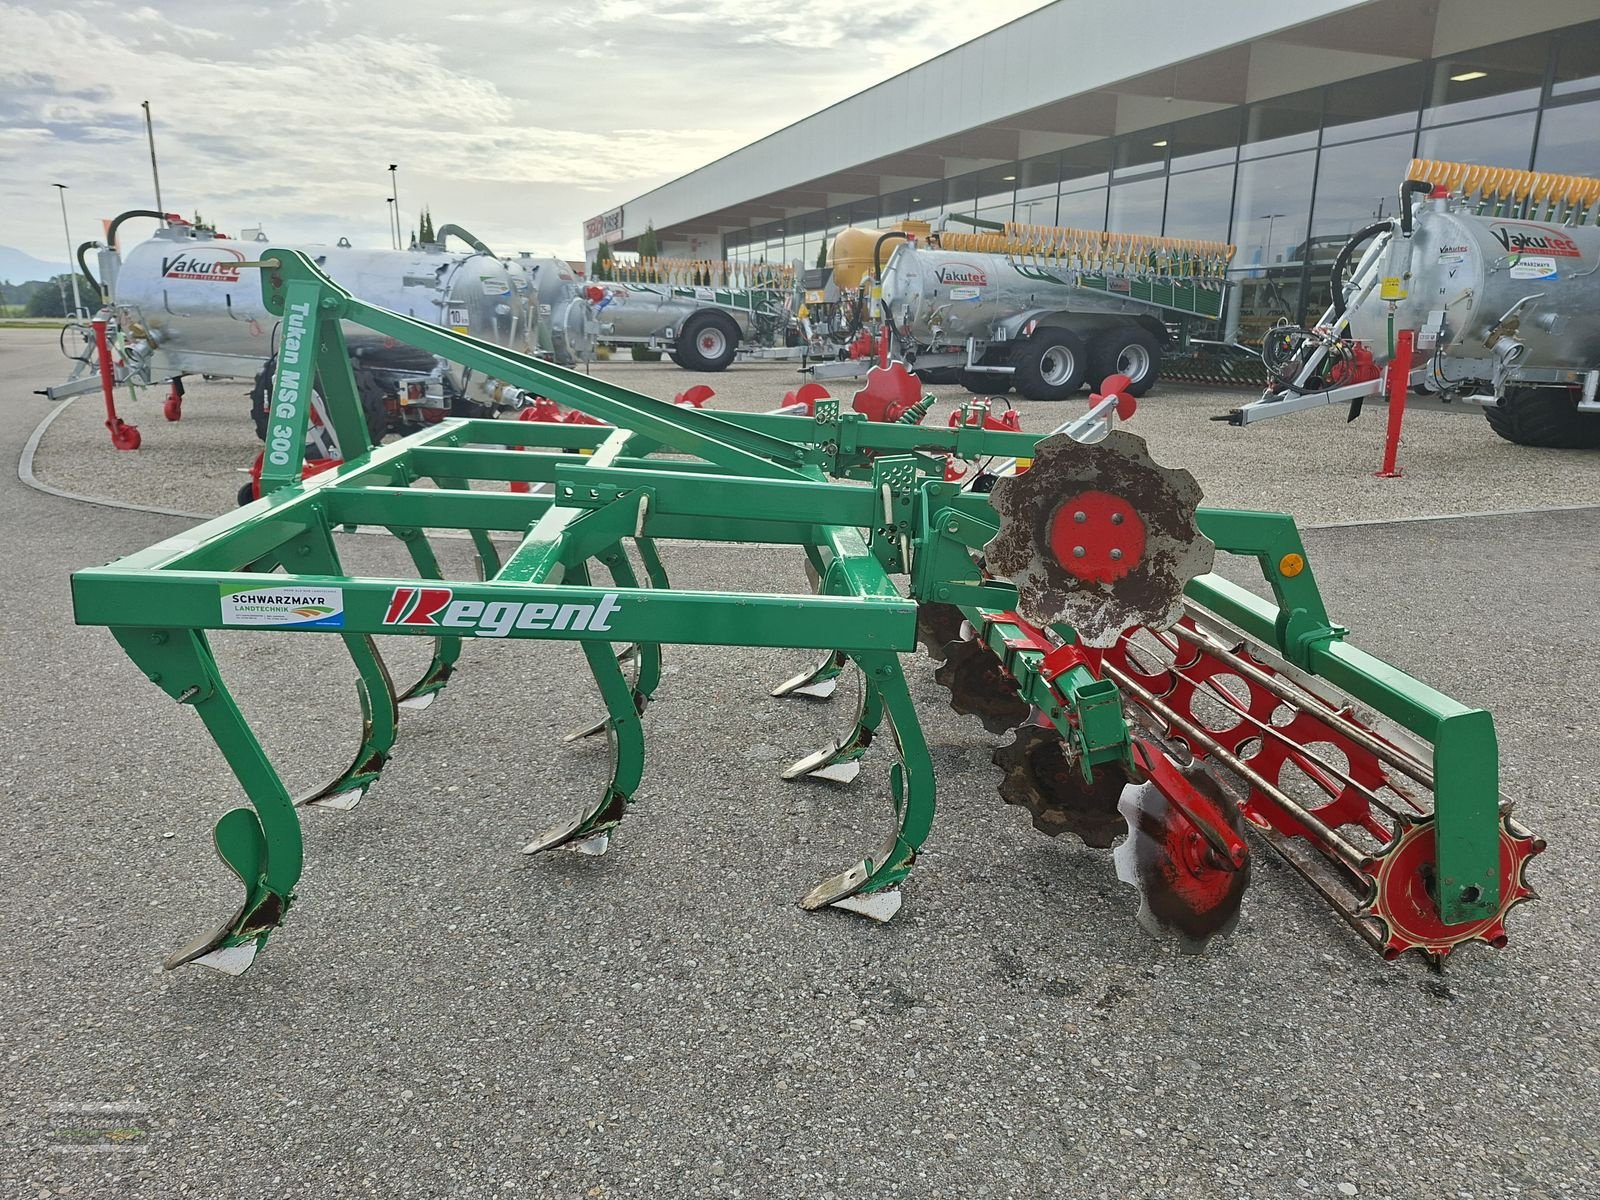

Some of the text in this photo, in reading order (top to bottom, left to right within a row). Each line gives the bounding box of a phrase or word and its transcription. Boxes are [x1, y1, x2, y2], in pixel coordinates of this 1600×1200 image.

[1489, 227, 1578, 252] Vakutec
[162, 253, 241, 277] Vakutec
[934, 267, 987, 284] Vakutec
[1440, 287, 1446, 295] H
[451, 310, 461, 324] 10
[269, 302, 310, 466] Tukan MSG 300
[232, 594, 325, 605] SCHWARZMAYR
[234, 605, 289, 613] LANDTECHNIK
[382, 587, 622, 638] Regent
